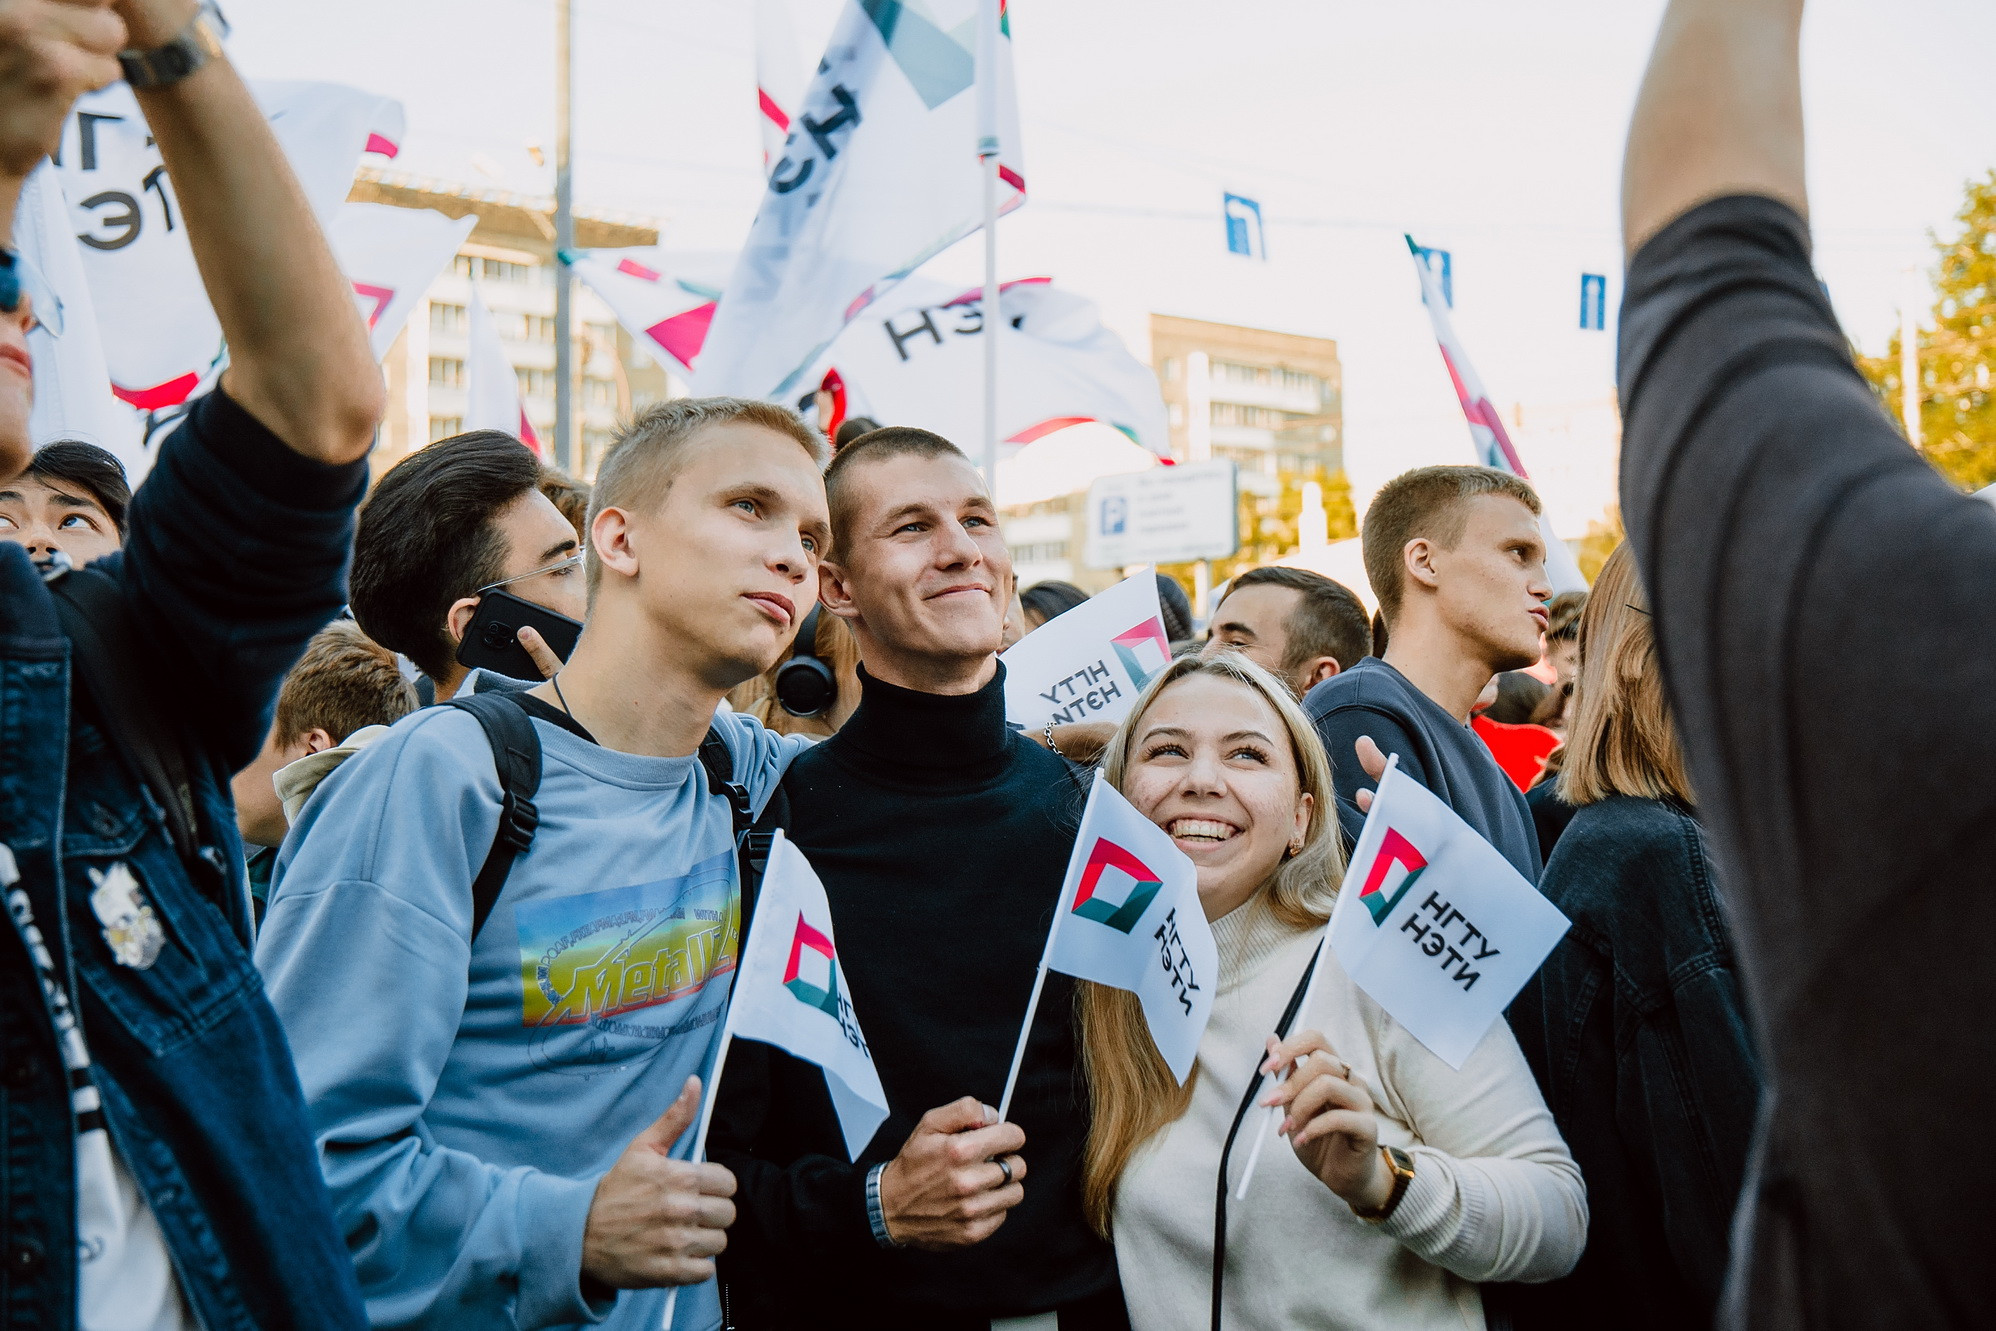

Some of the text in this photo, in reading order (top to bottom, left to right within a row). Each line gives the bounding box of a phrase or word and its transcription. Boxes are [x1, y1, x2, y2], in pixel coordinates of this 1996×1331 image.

[1165, 906, 1200, 991] НГТУ
[1400, 912, 1481, 992] НЭТИ
[1420, 890, 1500, 960] НГТУ
[1154, 923, 1192, 1017] НЭТИ
